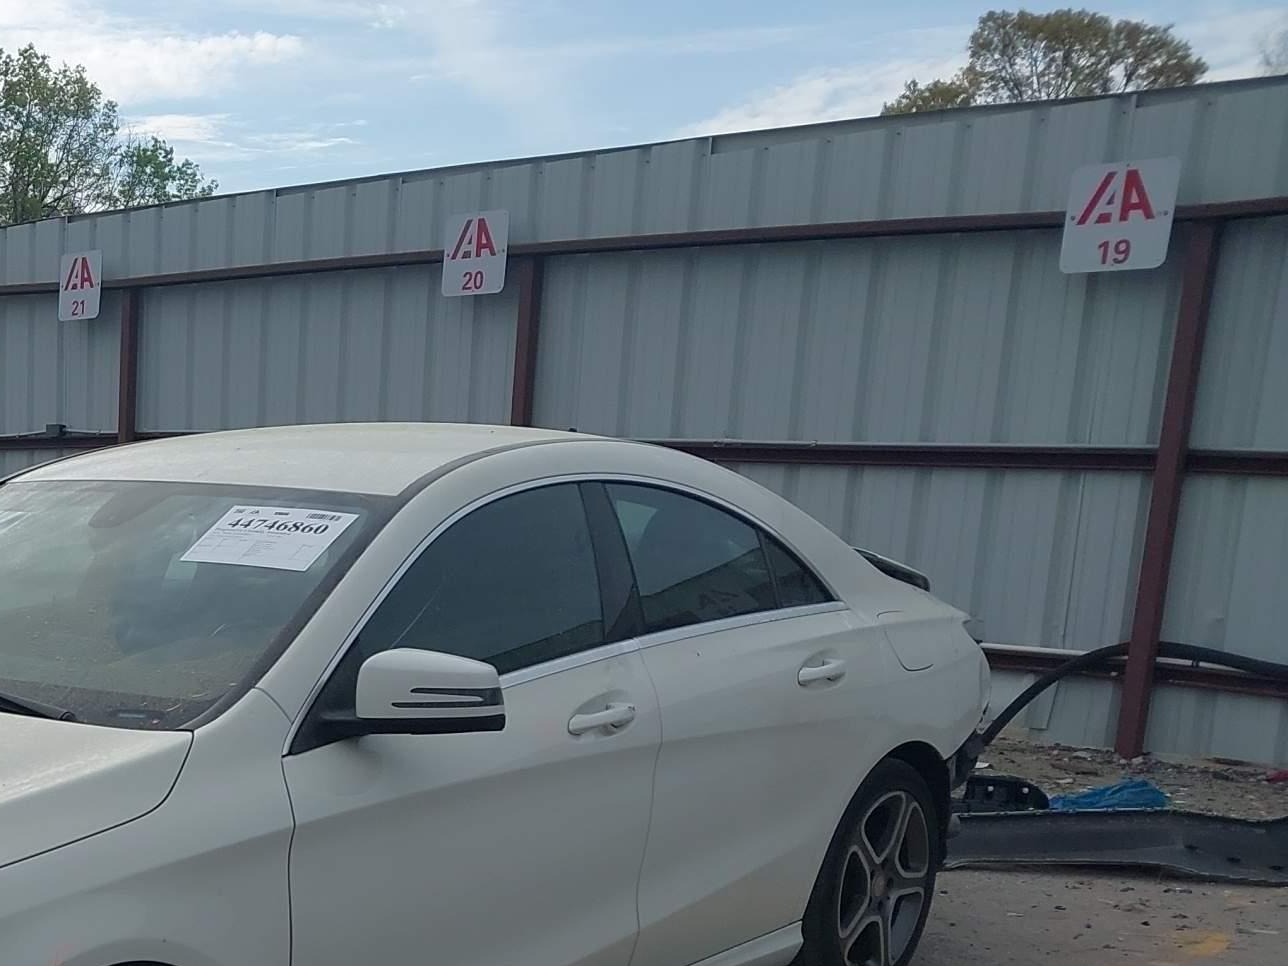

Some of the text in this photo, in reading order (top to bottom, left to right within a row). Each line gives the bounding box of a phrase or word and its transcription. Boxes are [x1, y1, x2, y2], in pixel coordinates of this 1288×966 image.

[1098, 239, 1131, 265] 19
[462, 270, 484, 290] 20
[72, 300, 85, 316] 21
[227, 518, 330, 535] 44746860
